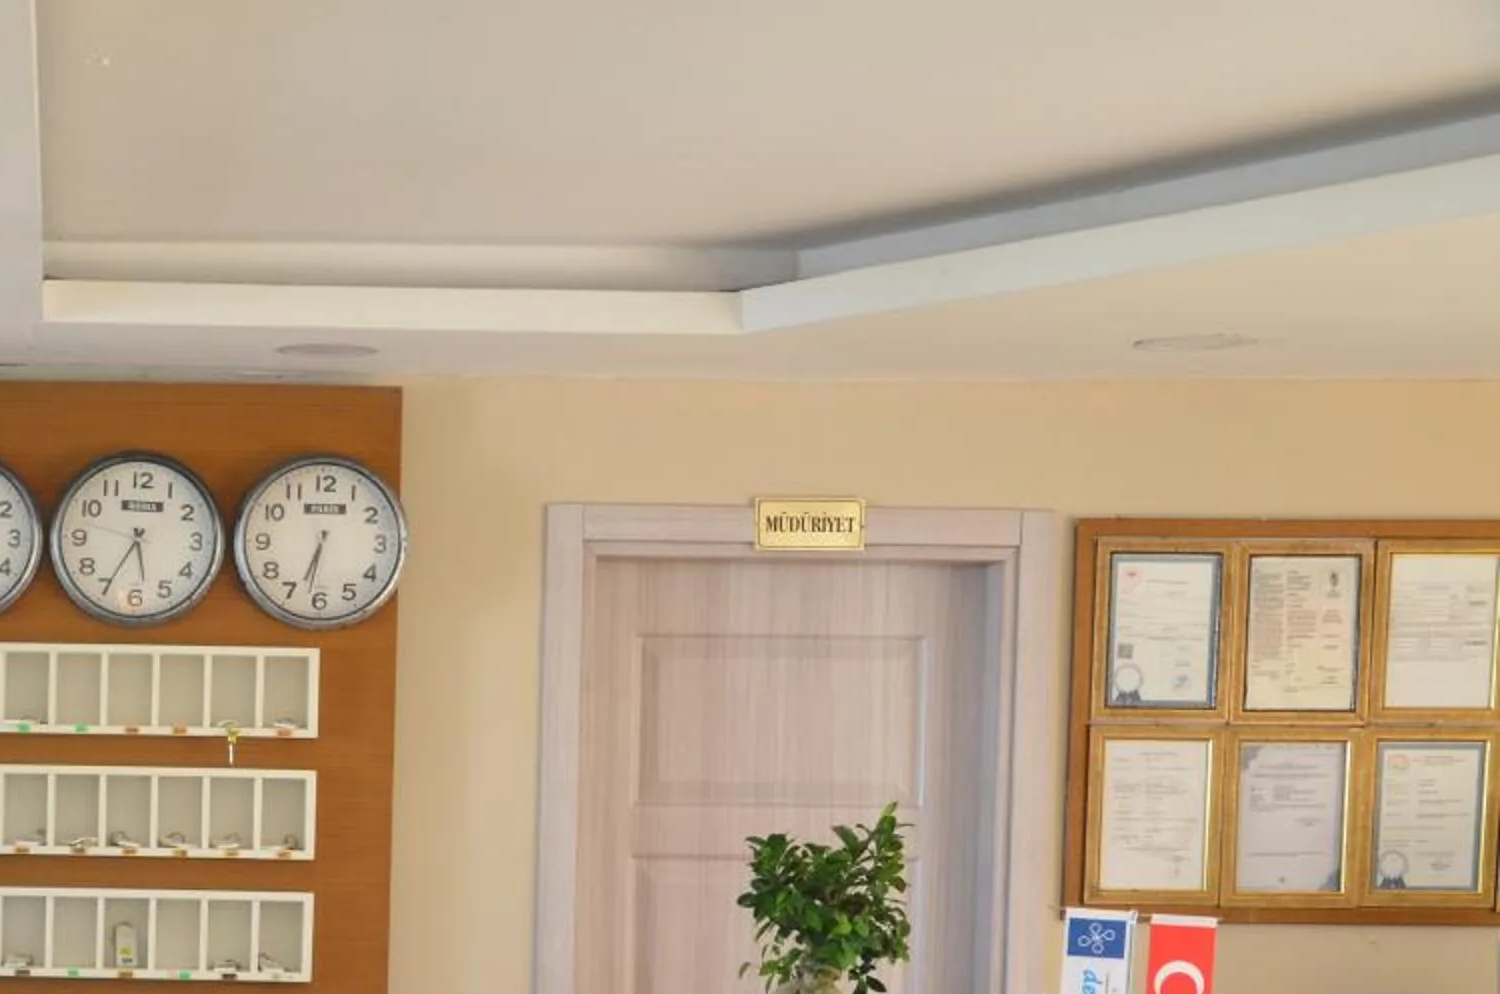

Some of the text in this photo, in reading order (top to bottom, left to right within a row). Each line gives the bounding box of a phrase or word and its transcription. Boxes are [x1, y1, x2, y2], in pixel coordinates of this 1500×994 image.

[103, 479, 119, 497] 11
[133, 471, 154, 489] 12
[316, 475, 337, 493] 12
[168, 482, 173, 499] 1
[286, 483, 302, 500] 11
[352, 484, 356, 501] 1
[82, 499, 102, 517] 10
[180, 504, 195, 521] 2
[265, 503, 285, 521] 10
[363, 507, 378, 524] 2
[765, 511, 856, 533] MÜDÜRİYET
[8, 529, 21, 547] 3
[71, 529, 87, 547] 9
[190, 532, 203, 551] 3
[255, 533, 271, 550] 9
[373, 534, 387, 553] 3
[78, 557, 96, 575] 8
[178, 562, 193, 579] 4
[263, 561, 279, 580] 8
[363, 564, 376, 582] 4
[98, 577, 112, 597] 7
[157, 580, 173, 598] 5
[282, 582, 297, 600] 7
[341, 583, 357, 601] 5
[127, 589, 143, 607] 6
[311, 592, 328, 610] 6
